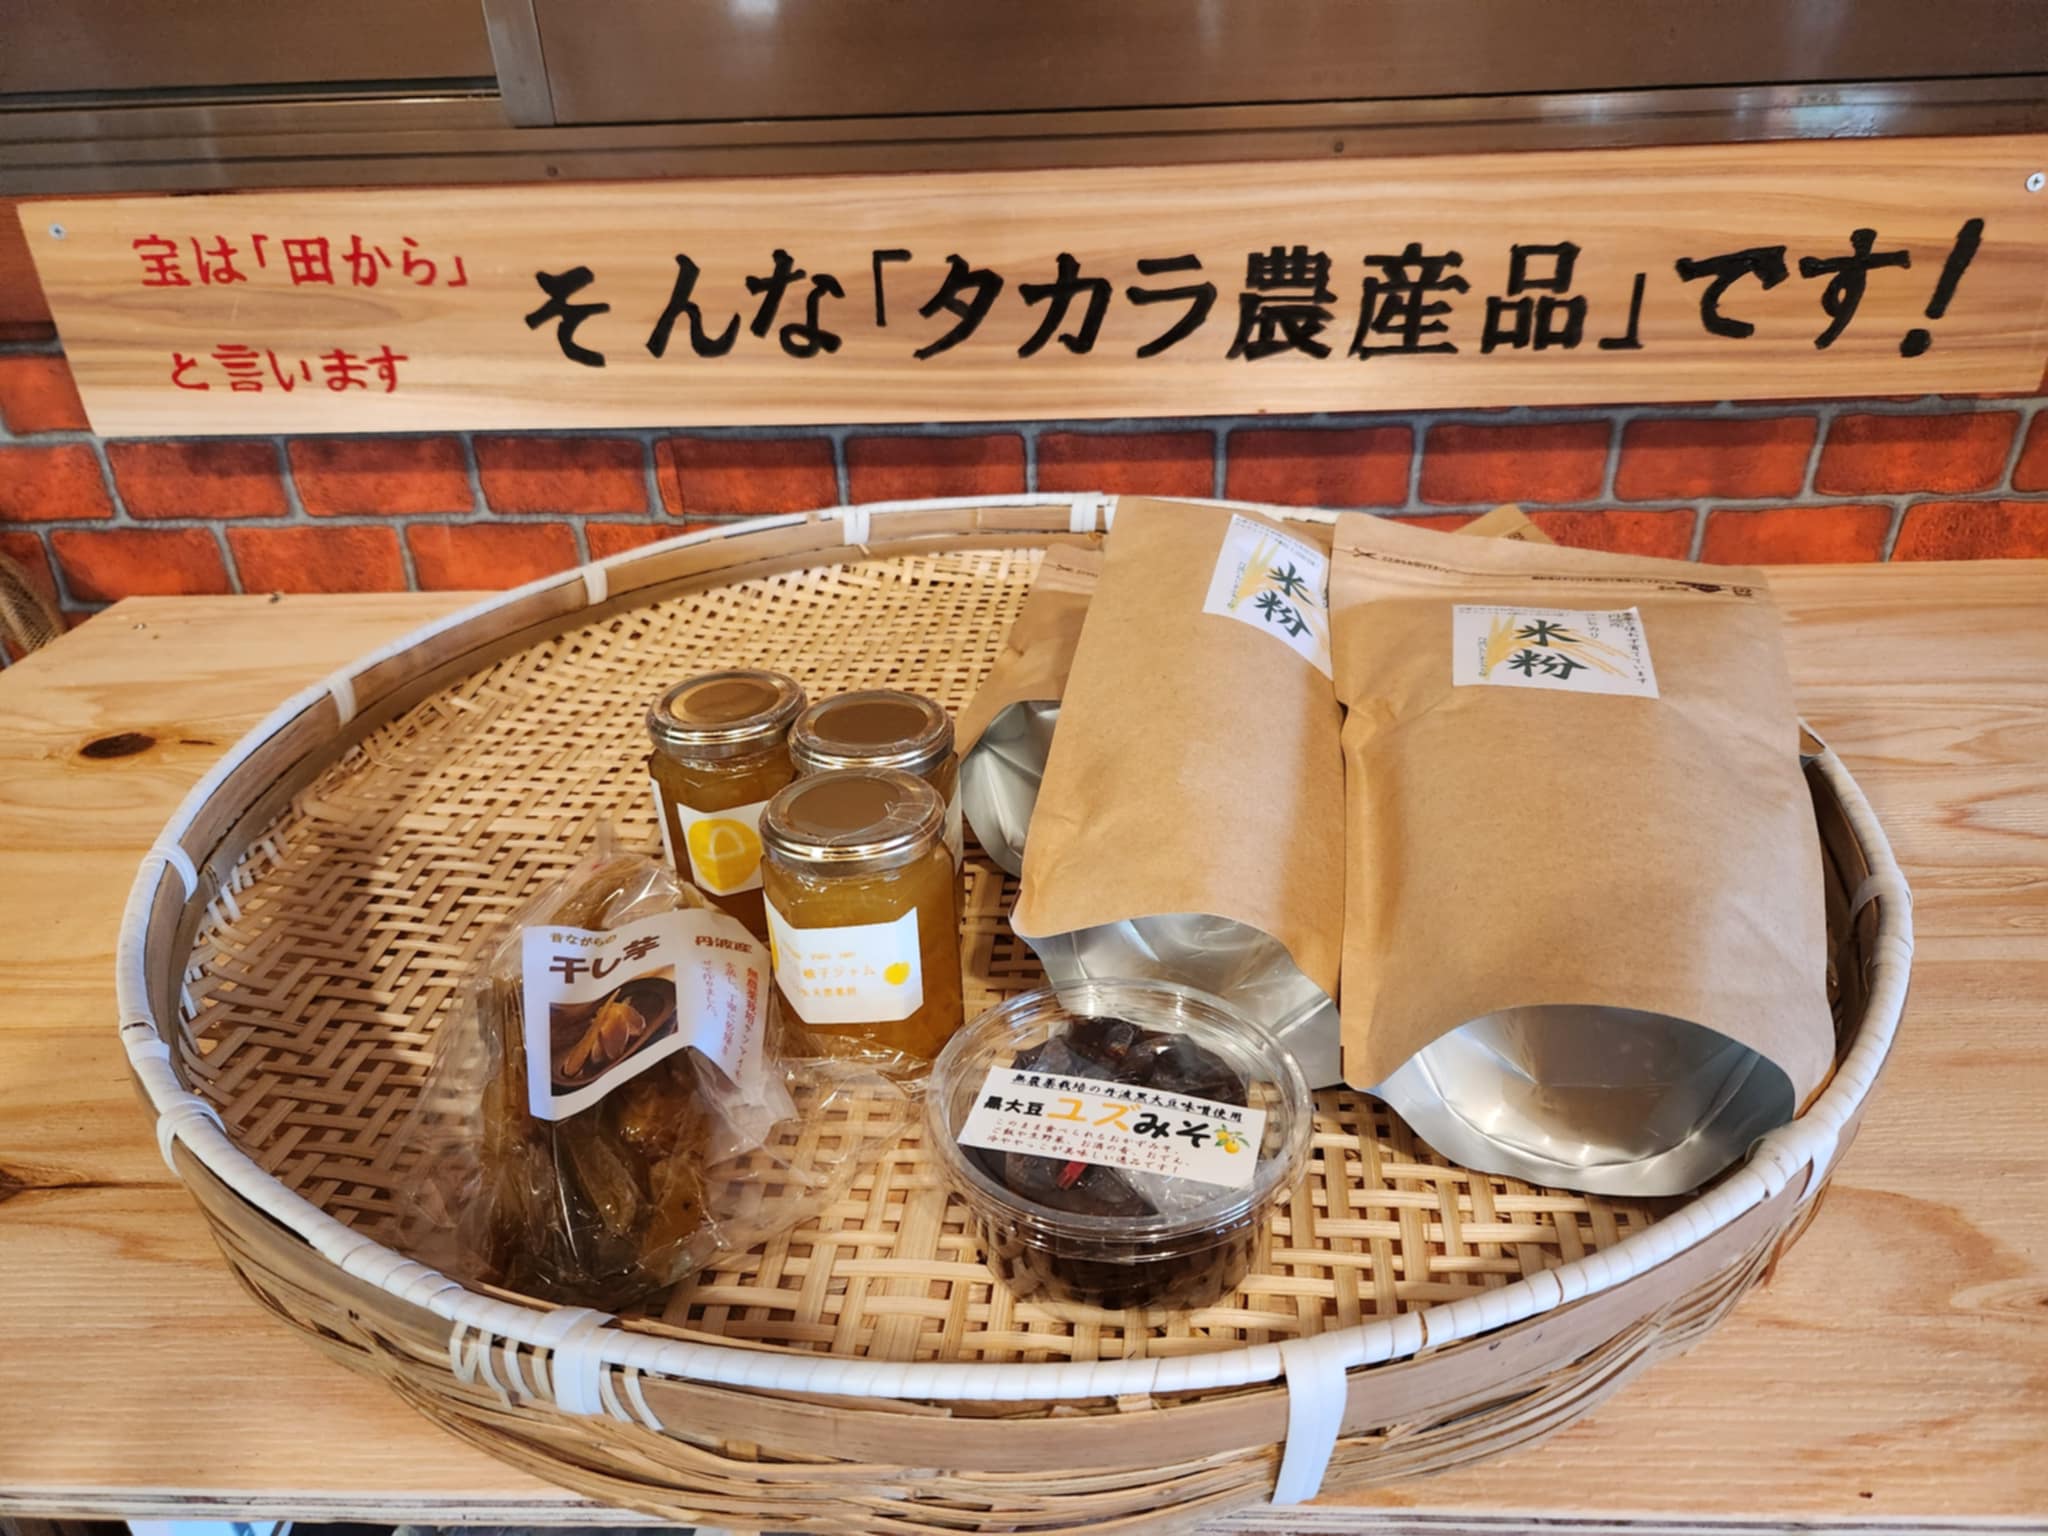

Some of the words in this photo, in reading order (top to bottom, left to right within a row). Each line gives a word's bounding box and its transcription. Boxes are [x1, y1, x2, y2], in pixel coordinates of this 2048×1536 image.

[133, 234, 469, 288] 宝は「田から」
[171, 345, 408, 393] と言います
[1253, 561, 1314, 638] 米粉
[1507, 618, 1589, 681] 米粉
[549, 935, 660, 984] 干し芋
[551, 932, 617, 948] 昔ながらの
